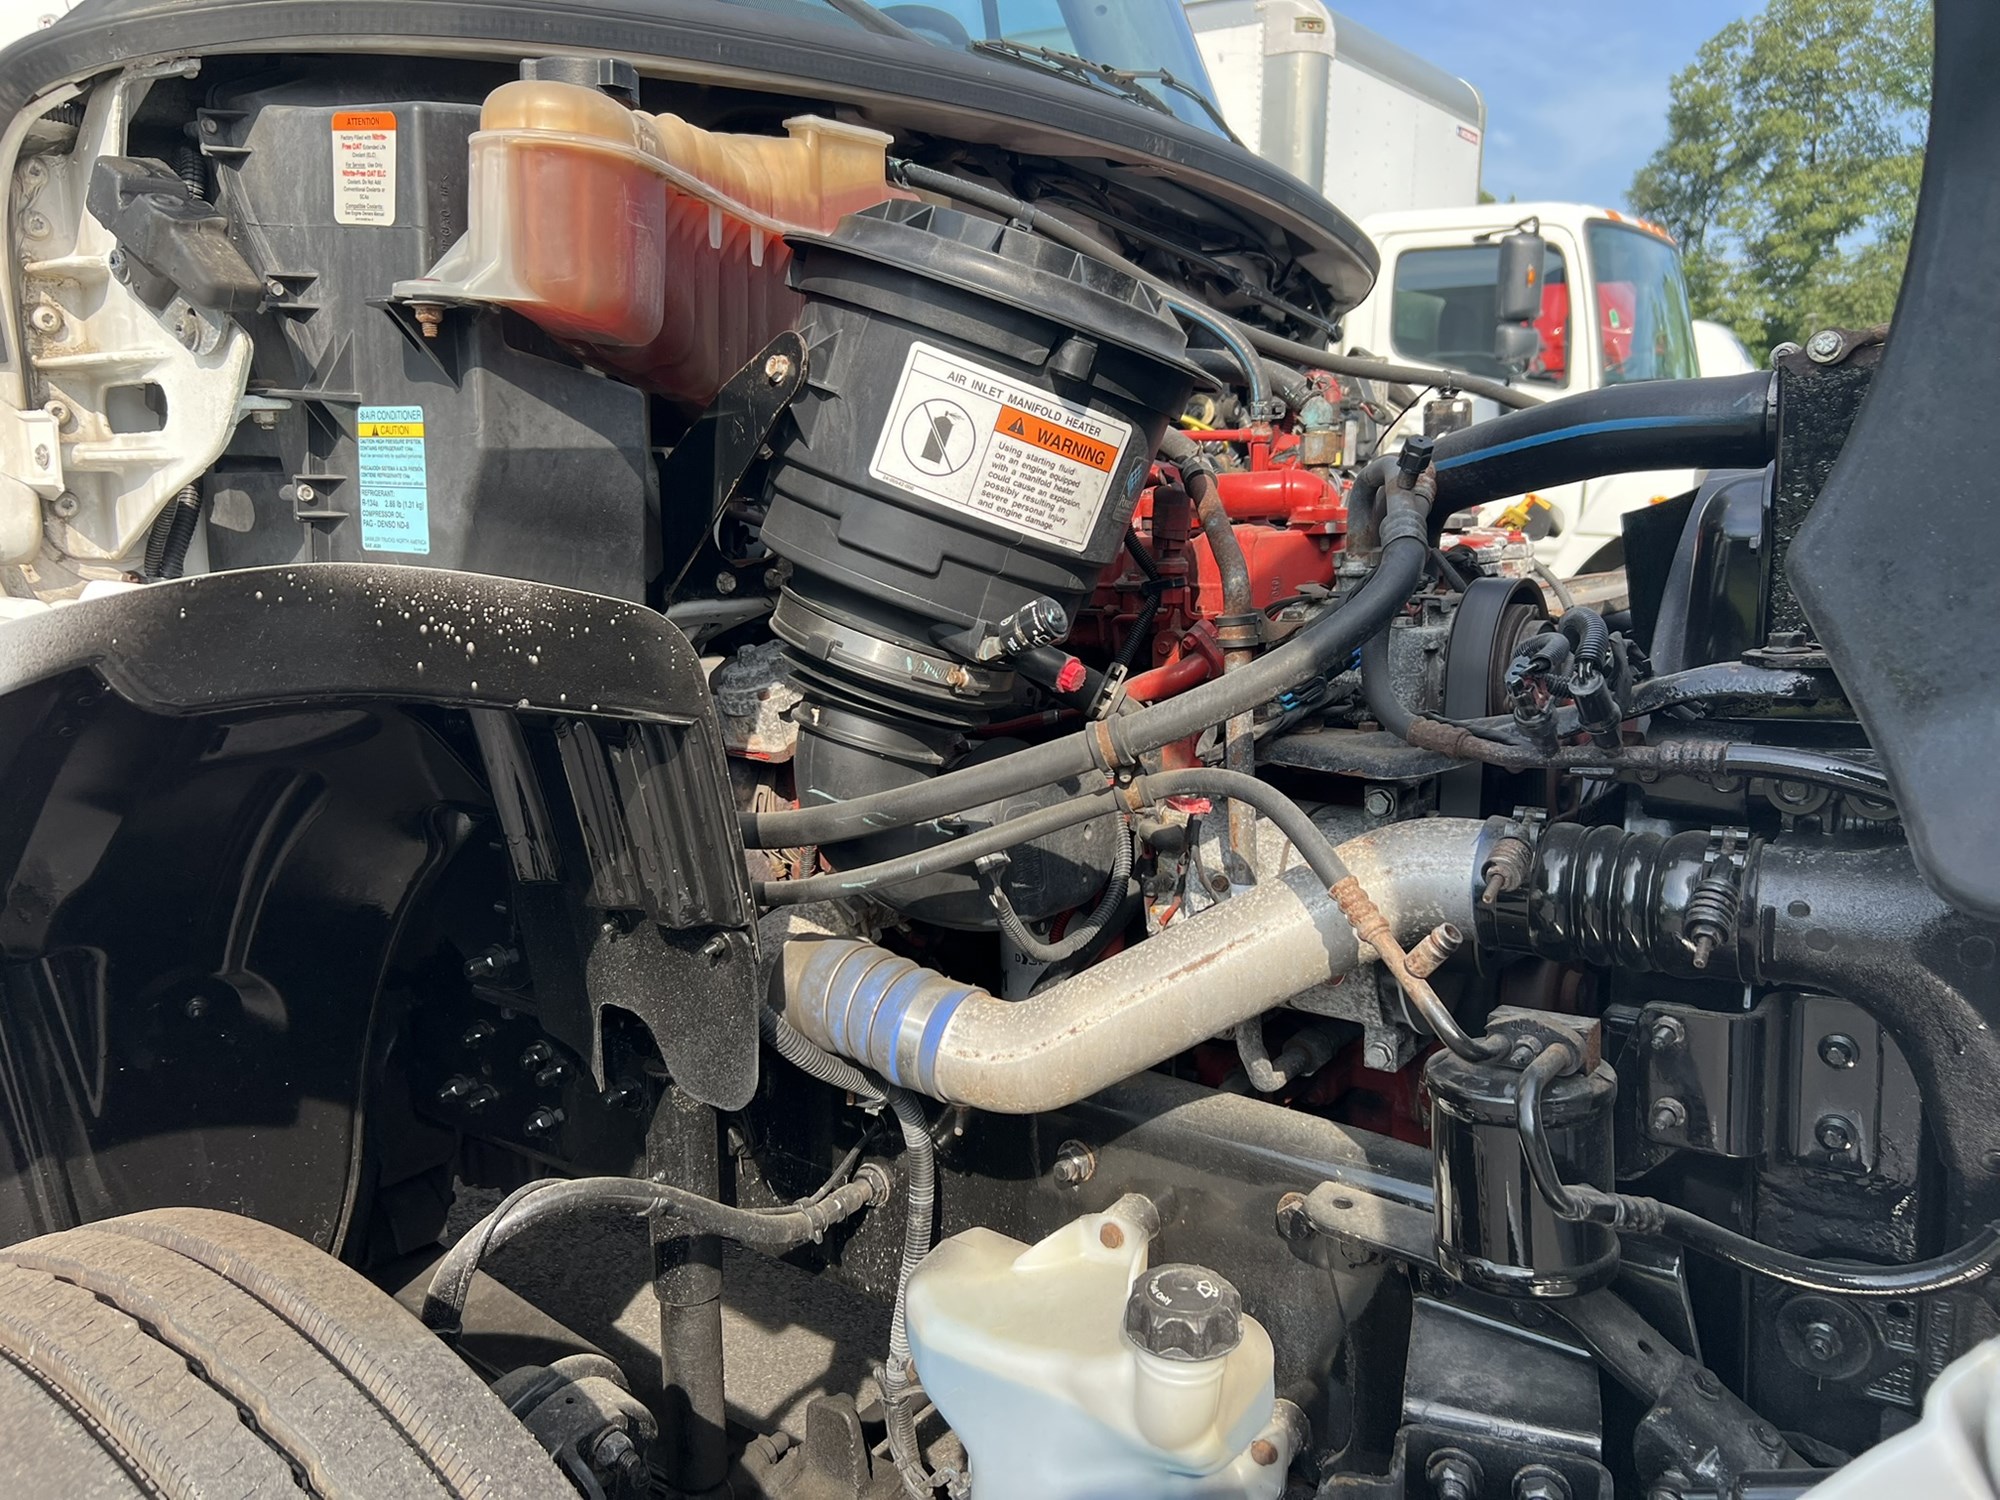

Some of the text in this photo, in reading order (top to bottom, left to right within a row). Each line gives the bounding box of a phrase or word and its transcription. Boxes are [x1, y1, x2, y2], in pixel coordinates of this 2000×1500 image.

[347, 117, 380, 126] ATTENTION
[365, 410, 422, 420] AIR CONDITIONER
[947, 371, 1102, 437] AIR INLET MANIFOLD HEATER
[380, 425, 410, 435] CAUTION
[998, 442, 1076, 476] Using starting fluid
[1036, 427, 1106, 466] WARNING
[988, 470, 1011, 484] could
[1013, 480, 1036, 493] cause
[1038, 488, 1048, 497] an
[992, 462, 1008, 472] with
[1019, 472, 1052, 488] manifold
[1053, 483, 1075, 496] heater
[994, 452, 1081, 488] on an engine equipped
[397, 500, 401, 508] lb
[416, 502, 424, 511] kg)
[981, 489, 1068, 526] severe personal injury
[984, 480, 1066, 514] possibly resulting in
[362, 510, 394, 518] COMPRESSOR
[363, 519, 373, 527] PAG
[377, 520, 396, 528] DENSO
[978, 498, 1054, 530] and engine damage.
[1156, 1292, 1172, 1306] Only
